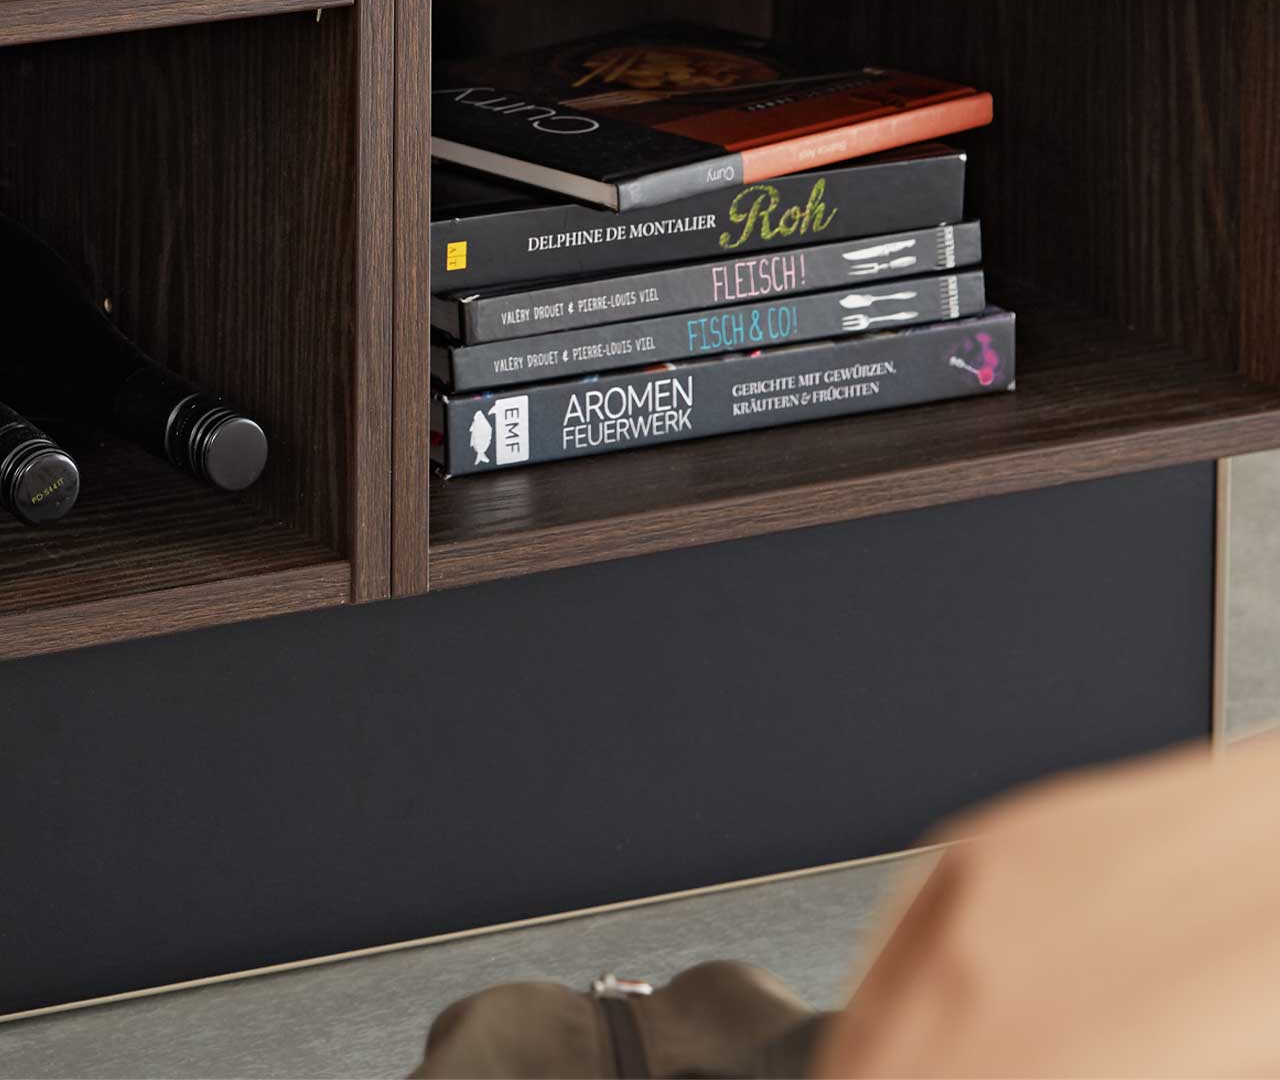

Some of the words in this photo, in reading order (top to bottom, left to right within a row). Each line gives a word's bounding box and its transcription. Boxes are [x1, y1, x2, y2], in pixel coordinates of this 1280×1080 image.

[706, 166, 735, 183] Curry
[527, 228, 603, 252] DELPHINE
[606, 226, 627, 243] DE
[629, 214, 717, 238] MONTALIER
[719, 177, 838, 249] Roh
[533, 302, 565, 320] DROUET
[577, 291, 637, 313] PIERRE-LOUIS
[639, 287, 659, 303] VIEL
[711, 254, 806, 302] FLEISCH!
[527, 350, 559, 367] DROUET
[572, 339, 632, 361] PIERRE-LOUIS
[635, 336, 656, 352] VIEL
[687, 311, 745, 352] FISCH
[748, 309, 764, 342] &
[767, 305, 799, 340] CO!
[563, 375, 693, 426] AROMEN
[731, 375, 796, 398] GERICHTE
[798, 372, 823, 388] MIT
[823, 360, 897, 384] GEWÜRZEN,
[732, 393, 799, 416] KRÄUTERN
[800, 392, 811, 406] &
[812, 380, 880, 404] FRÜCHTEN
[504, 406, 521, 455] EMF
[563, 407, 693, 451] FEUERWERK
